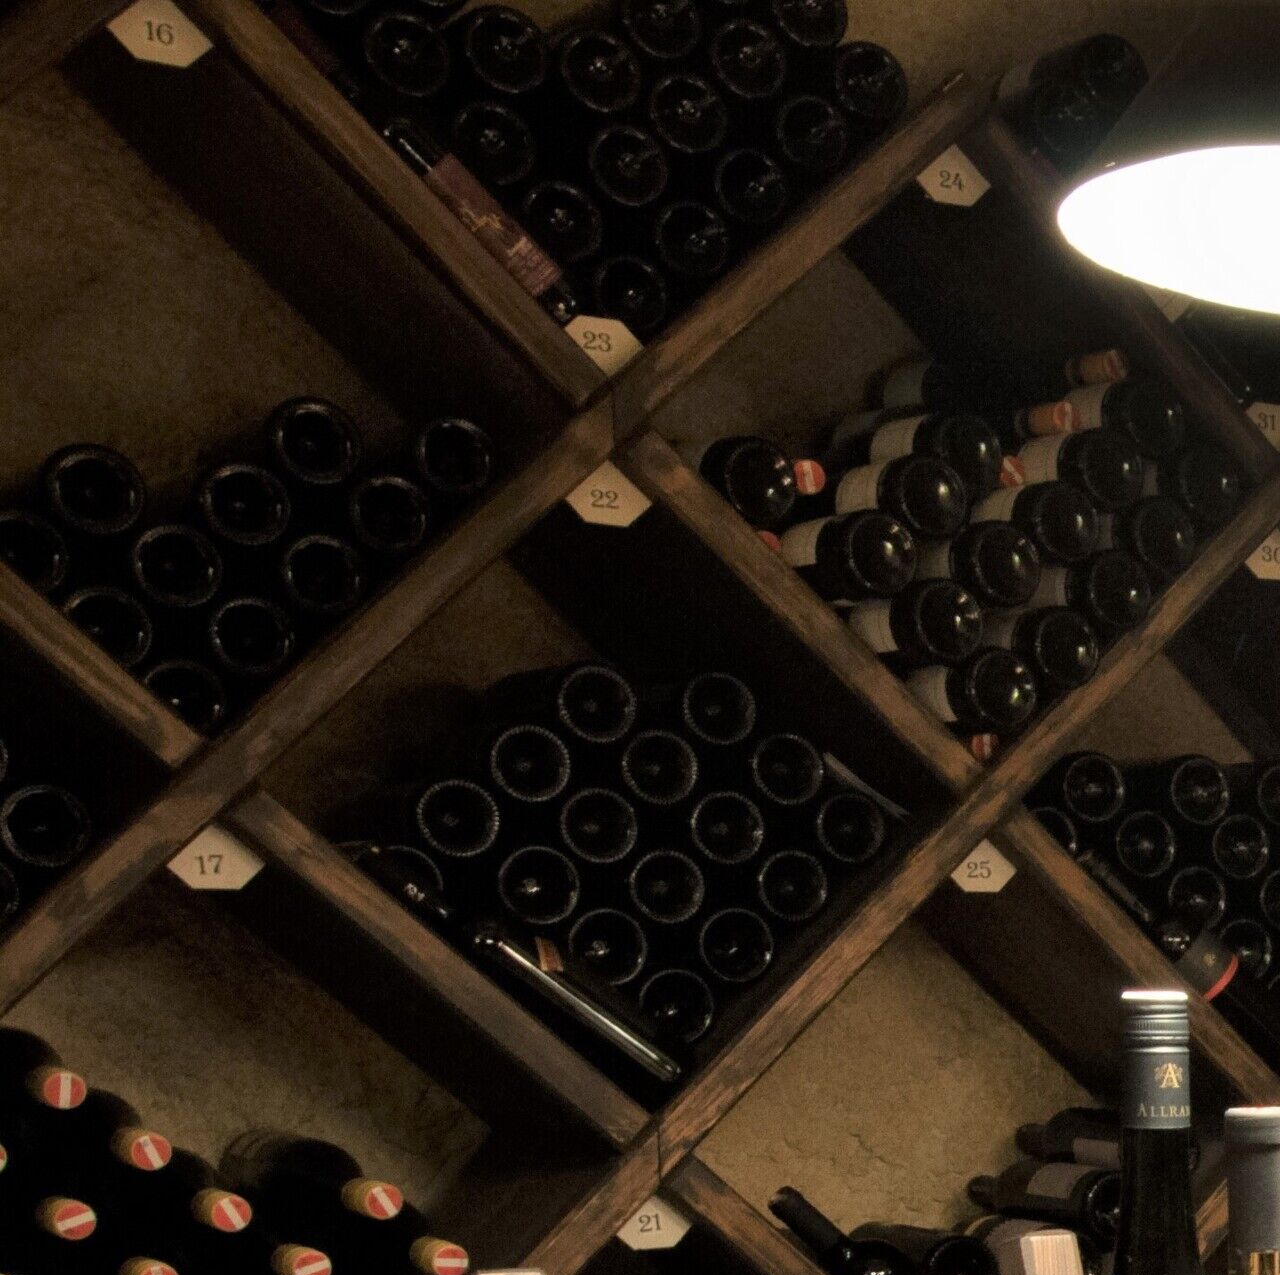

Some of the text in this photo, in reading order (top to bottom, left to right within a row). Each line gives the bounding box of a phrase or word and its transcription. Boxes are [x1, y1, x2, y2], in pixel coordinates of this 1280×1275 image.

[144, 20, 173, 46] 16
[938, 169, 964, 191] 24
[582, 331, 611, 353] 23
[1257, 412, 1276, 431] 31
[590, 489, 619, 509] 22
[195, 854, 223, 876] 17
[966, 861, 992, 879] 25
[638, 1213, 663, 1232] 21
